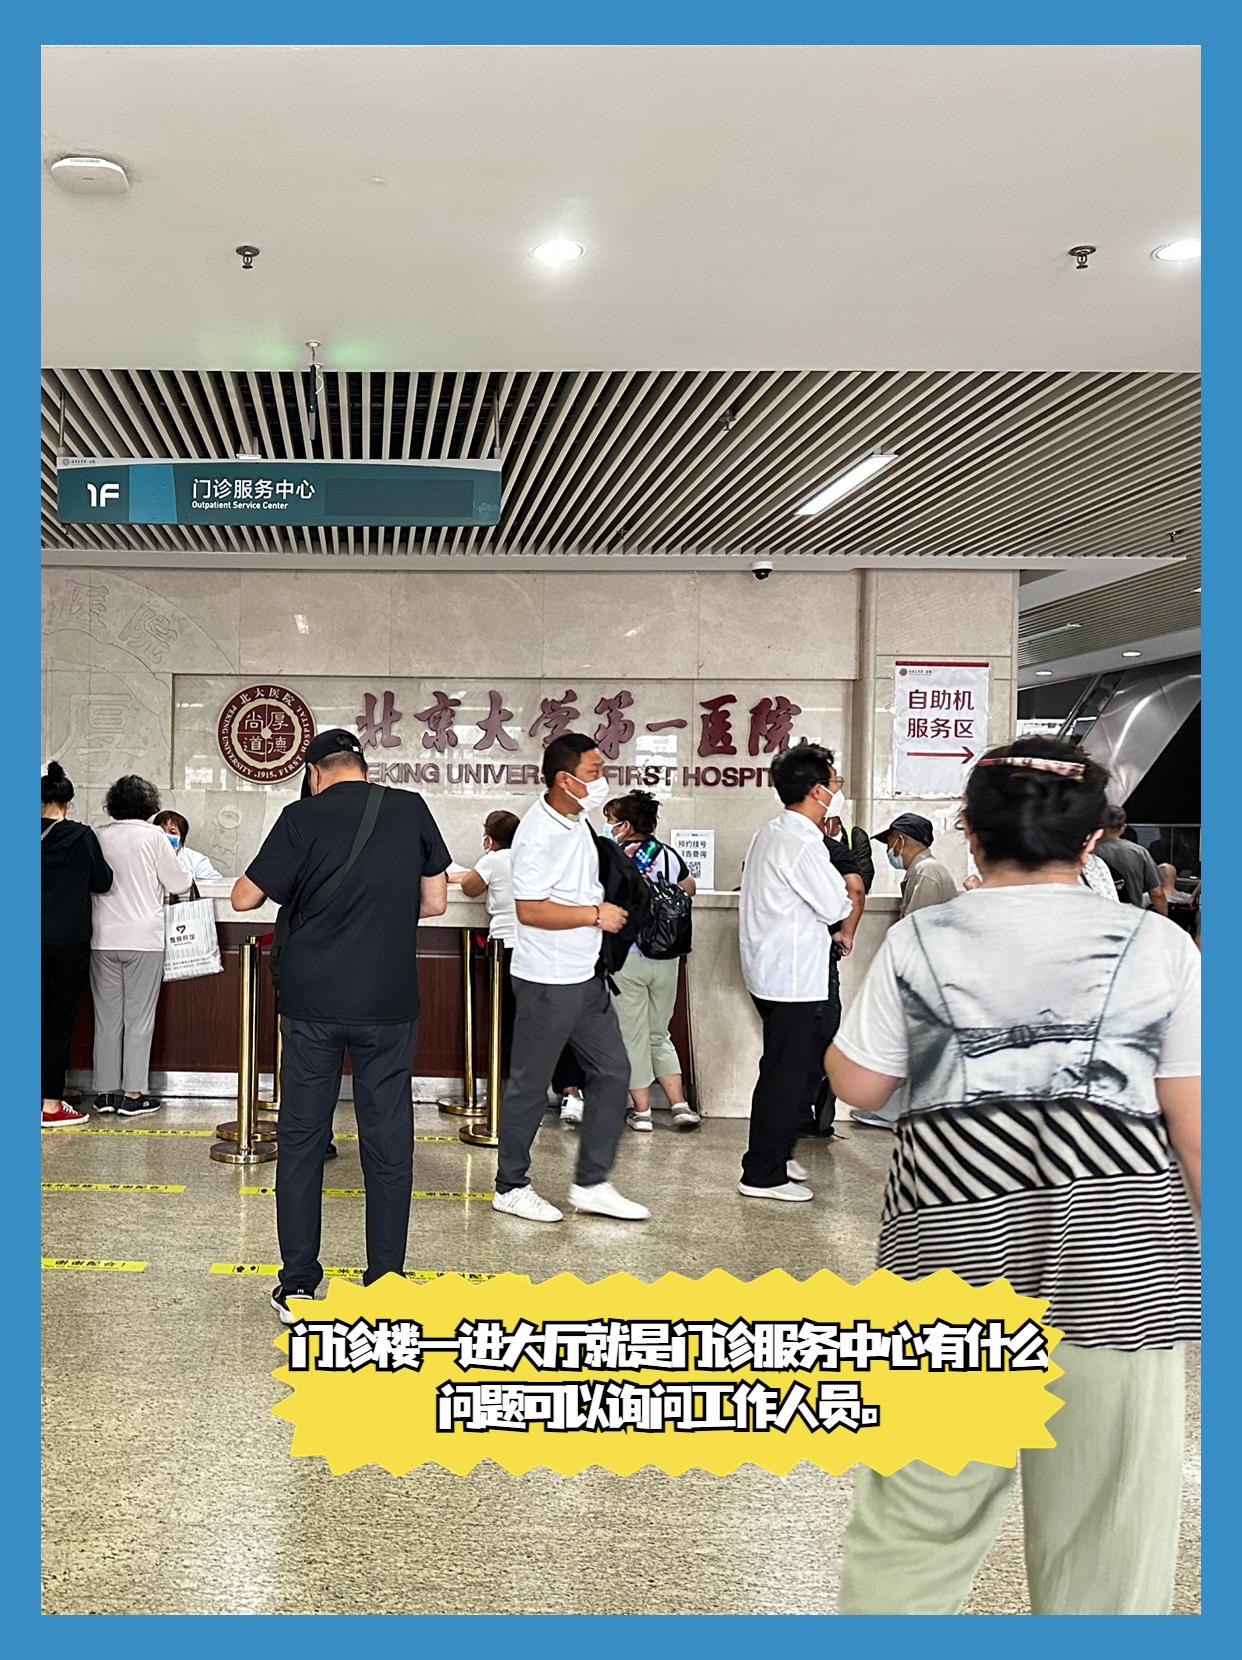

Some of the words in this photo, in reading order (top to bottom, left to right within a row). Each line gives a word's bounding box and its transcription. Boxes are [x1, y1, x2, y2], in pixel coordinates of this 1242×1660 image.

[87, 483, 120, 507] 1F
[192, 478, 316, 500] 门诊服务中心
[192, 500, 231, 511] Outpatient
[232, 500, 261, 510] Service
[262, 501, 289, 510] Center
[239, 687, 296, 707] 北大医院
[908, 689, 975, 711] 自助机
[221, 704, 238, 734] PEKING
[355, 689, 808, 760] 北京大学第一医院
[907, 717, 975, 739] 服务区
[278, 755, 303, 776] FIRST
[296, 705, 311, 754] HOSPITAL
[222, 736, 254, 776] UNIVERSITY
[367, 762, 440, 784] EKING
[603, 765, 678, 786] FIRST
[682, 766, 774, 788] HOSPIT
